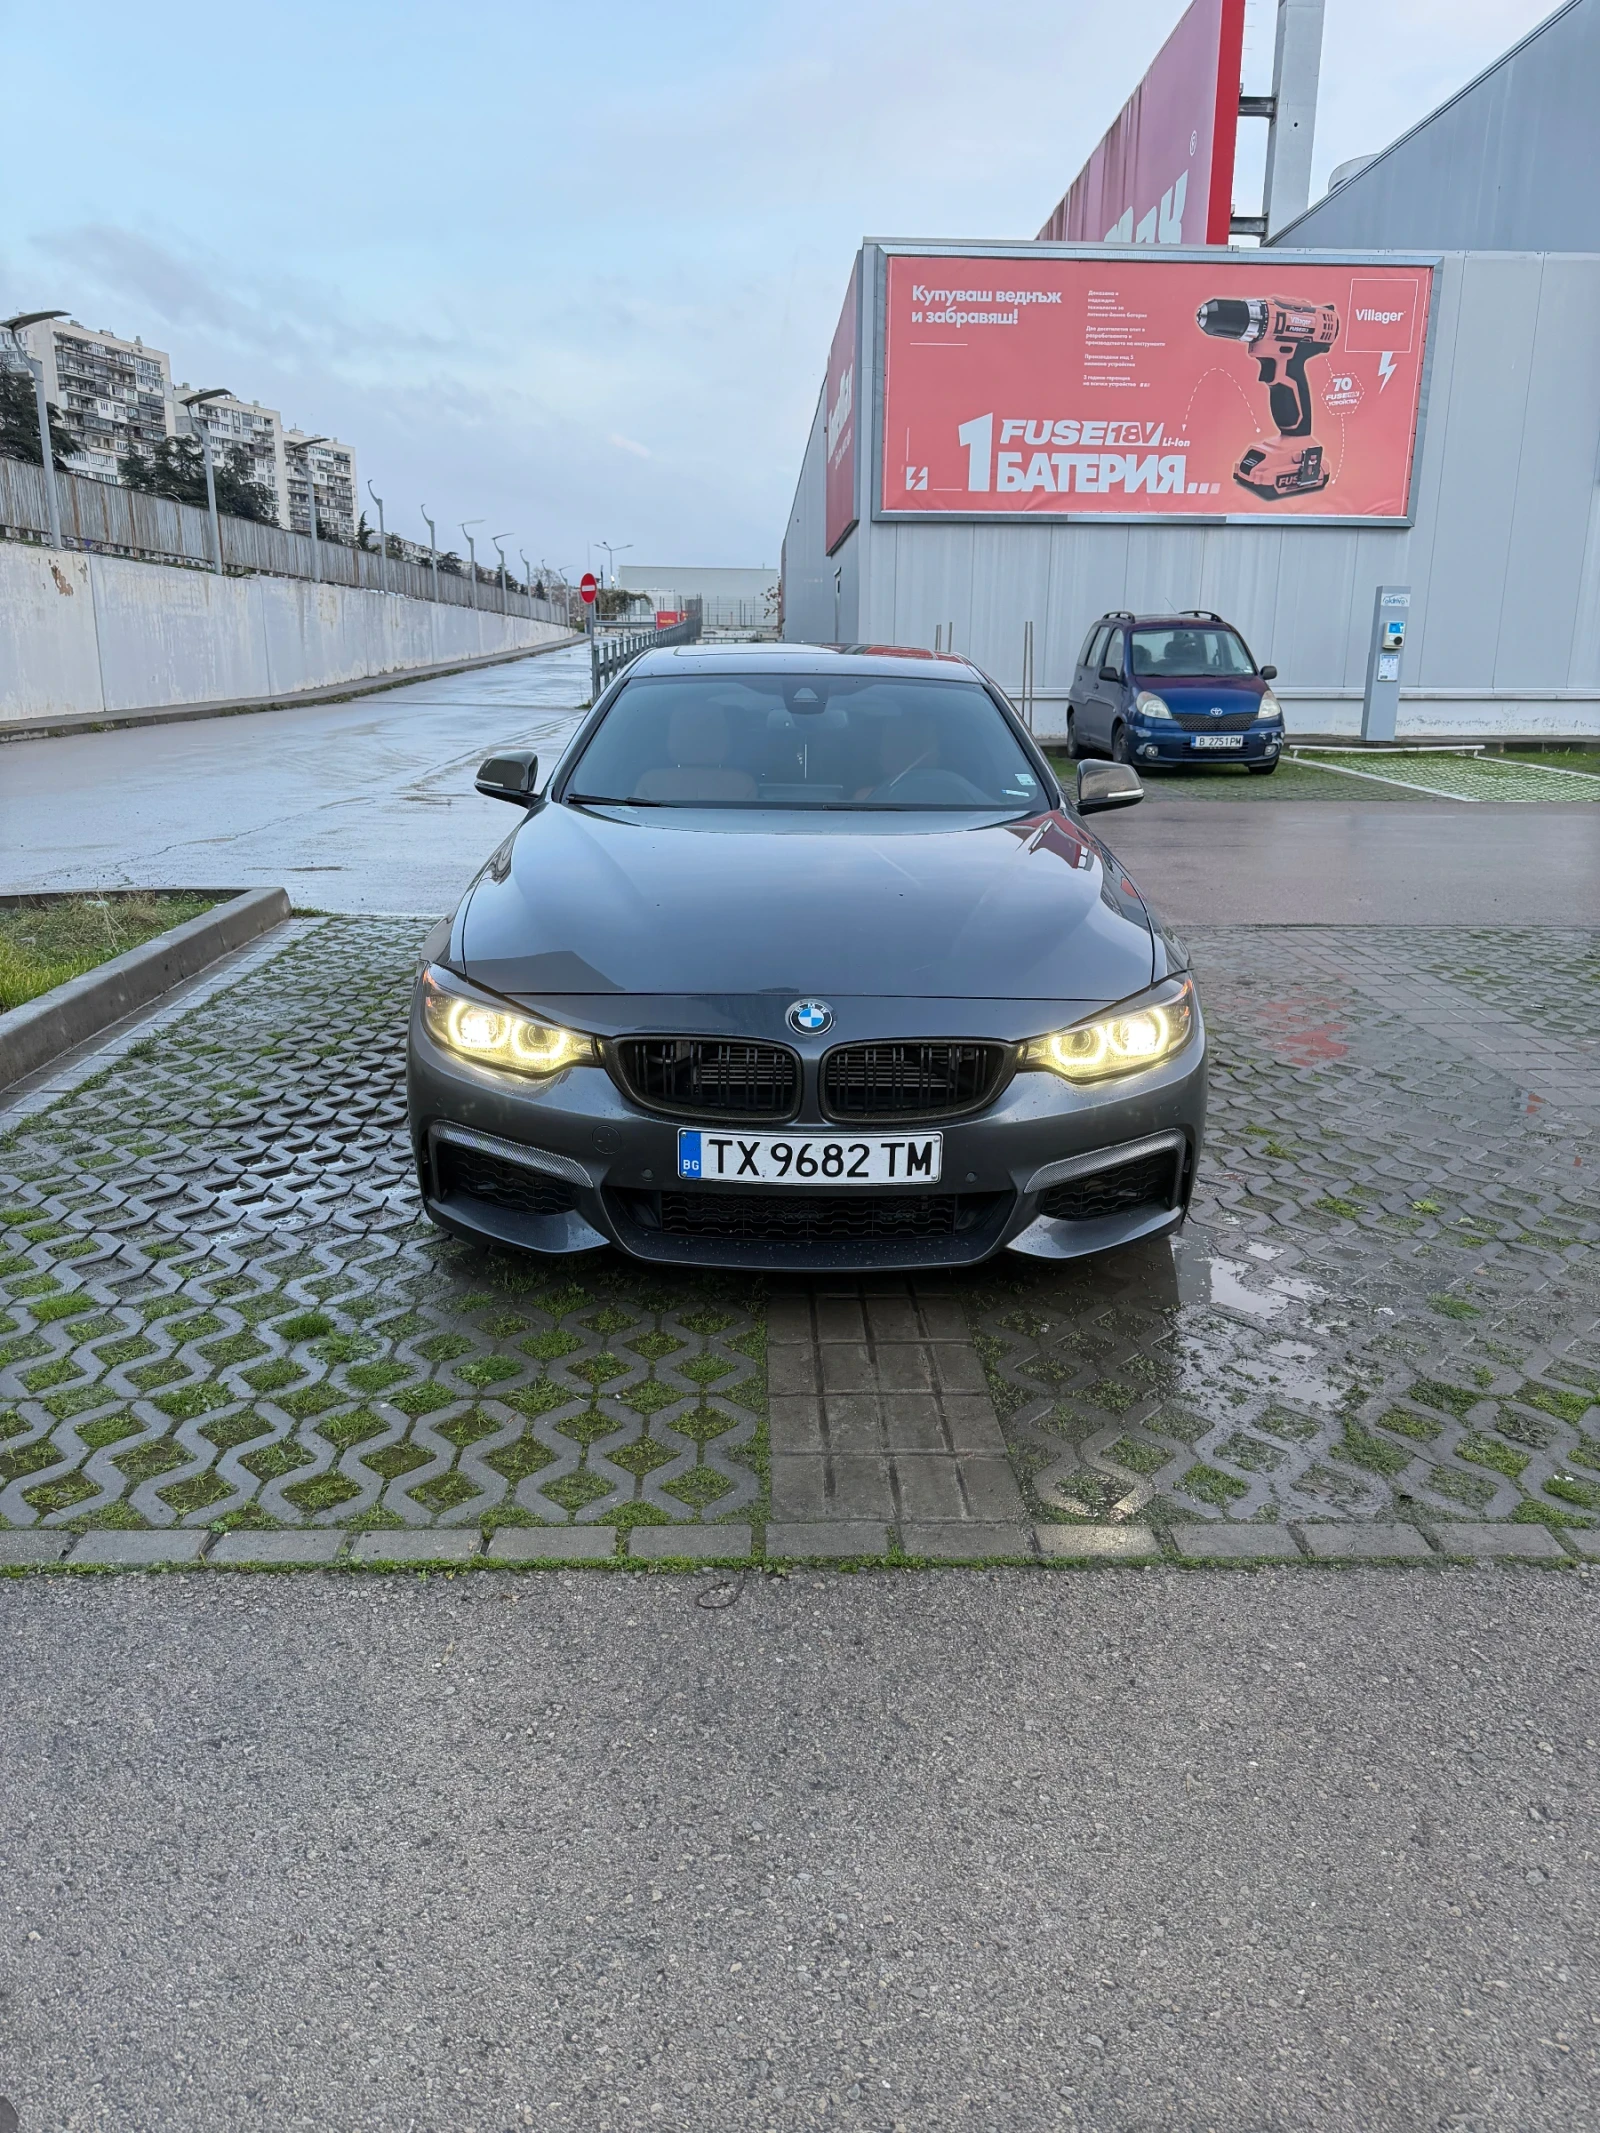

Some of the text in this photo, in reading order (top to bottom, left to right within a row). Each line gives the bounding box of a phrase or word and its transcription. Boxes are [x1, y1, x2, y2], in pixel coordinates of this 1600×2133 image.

[912, 284, 1063, 307] Купуваш веднъж
[911, 305, 1019, 329] и забравяш!
[1355, 308, 1405, 325] Villager
[1332, 376, 1353, 392] 70
[958, 412, 993, 492] 1
[1162, 437, 1191, 448] Li-Ion
[1199, 737, 1205, 746] B
[1208, 737, 1229, 746] 2751
[682, 1158, 700, 1171] BG
[707, 1138, 933, 1179] TX 9682 TM
